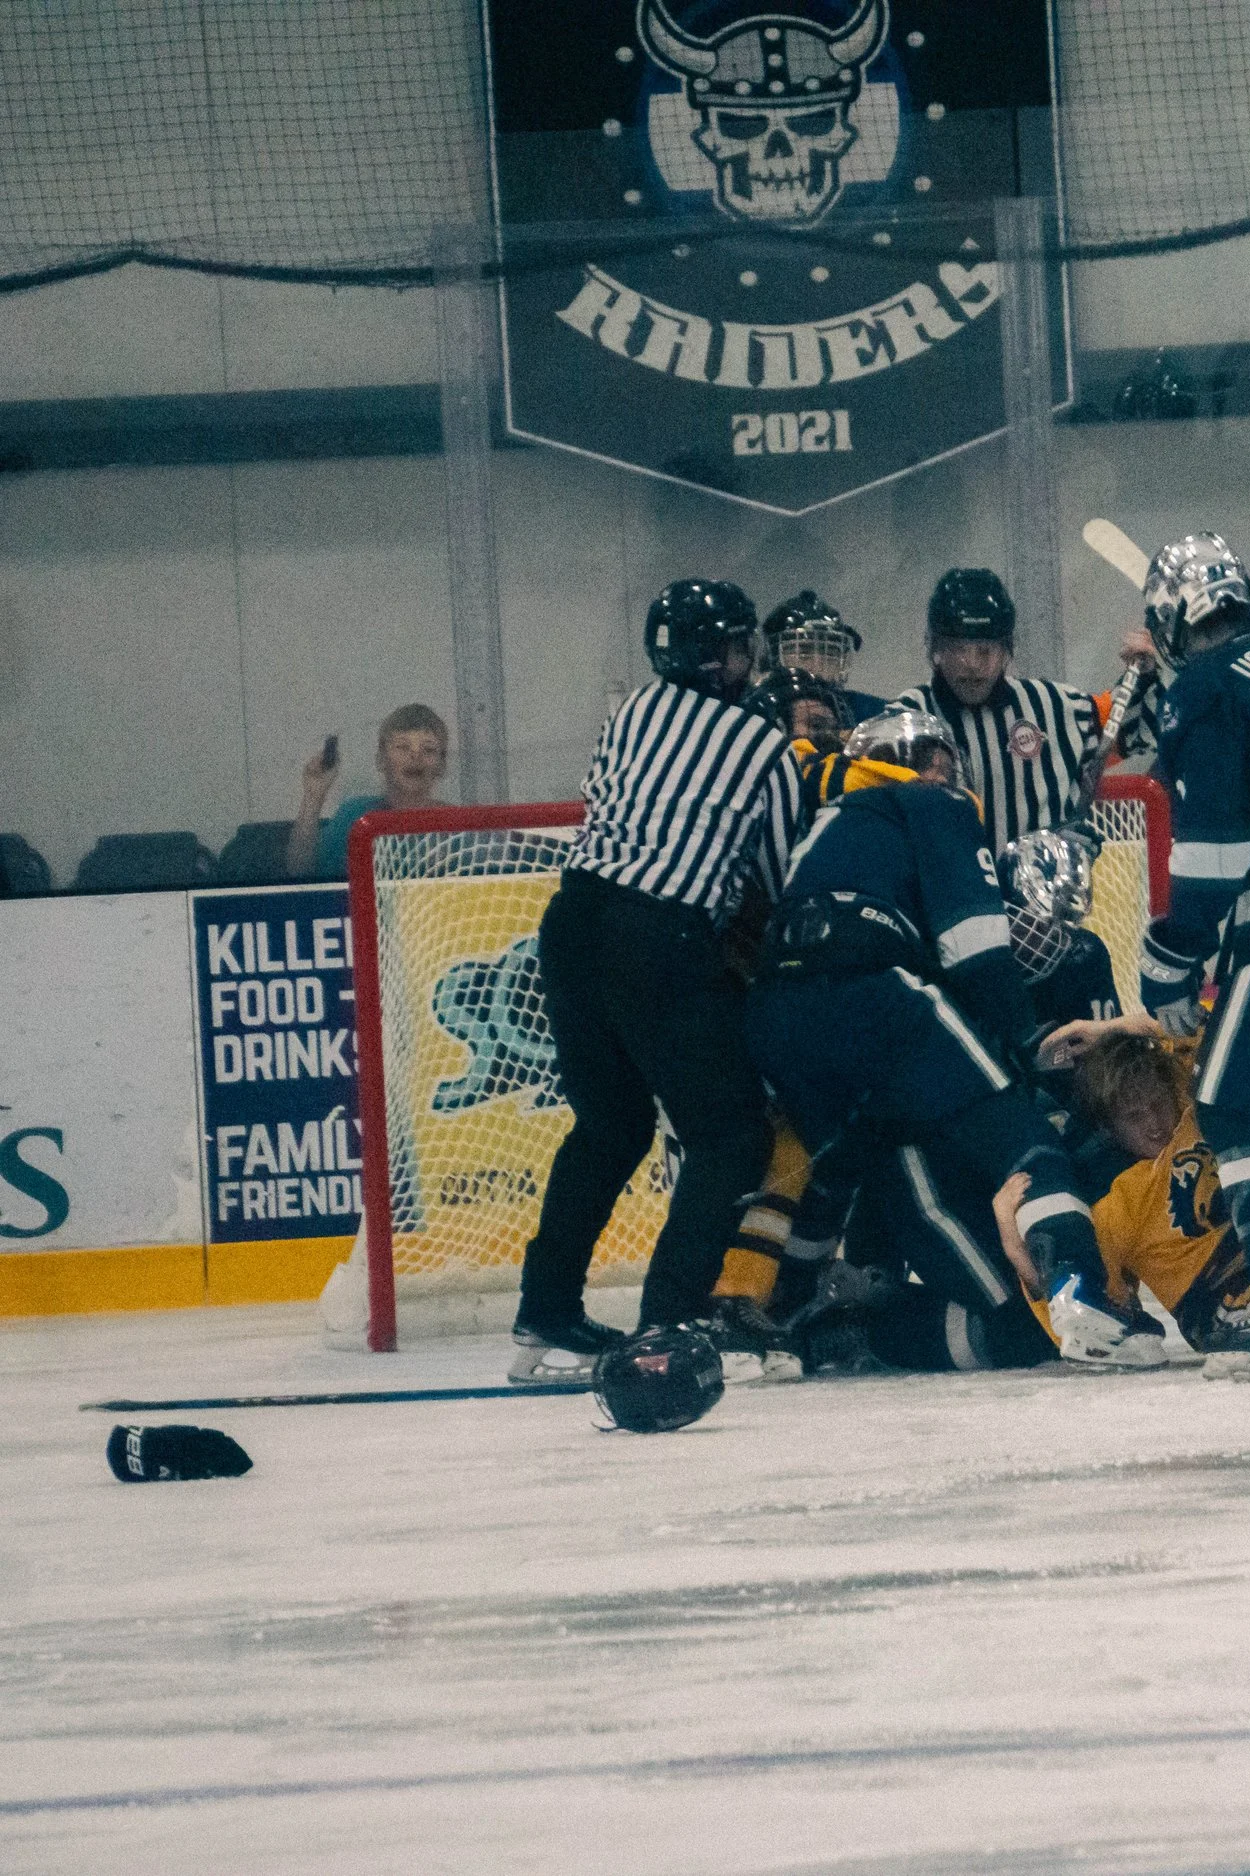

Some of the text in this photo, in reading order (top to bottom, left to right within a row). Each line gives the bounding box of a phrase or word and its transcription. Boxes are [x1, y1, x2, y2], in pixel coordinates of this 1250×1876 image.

[732, 409, 853, 456] 2021
[210, 976, 324, 1028] FOOD
[213, 1028, 359, 1084] DRINK
